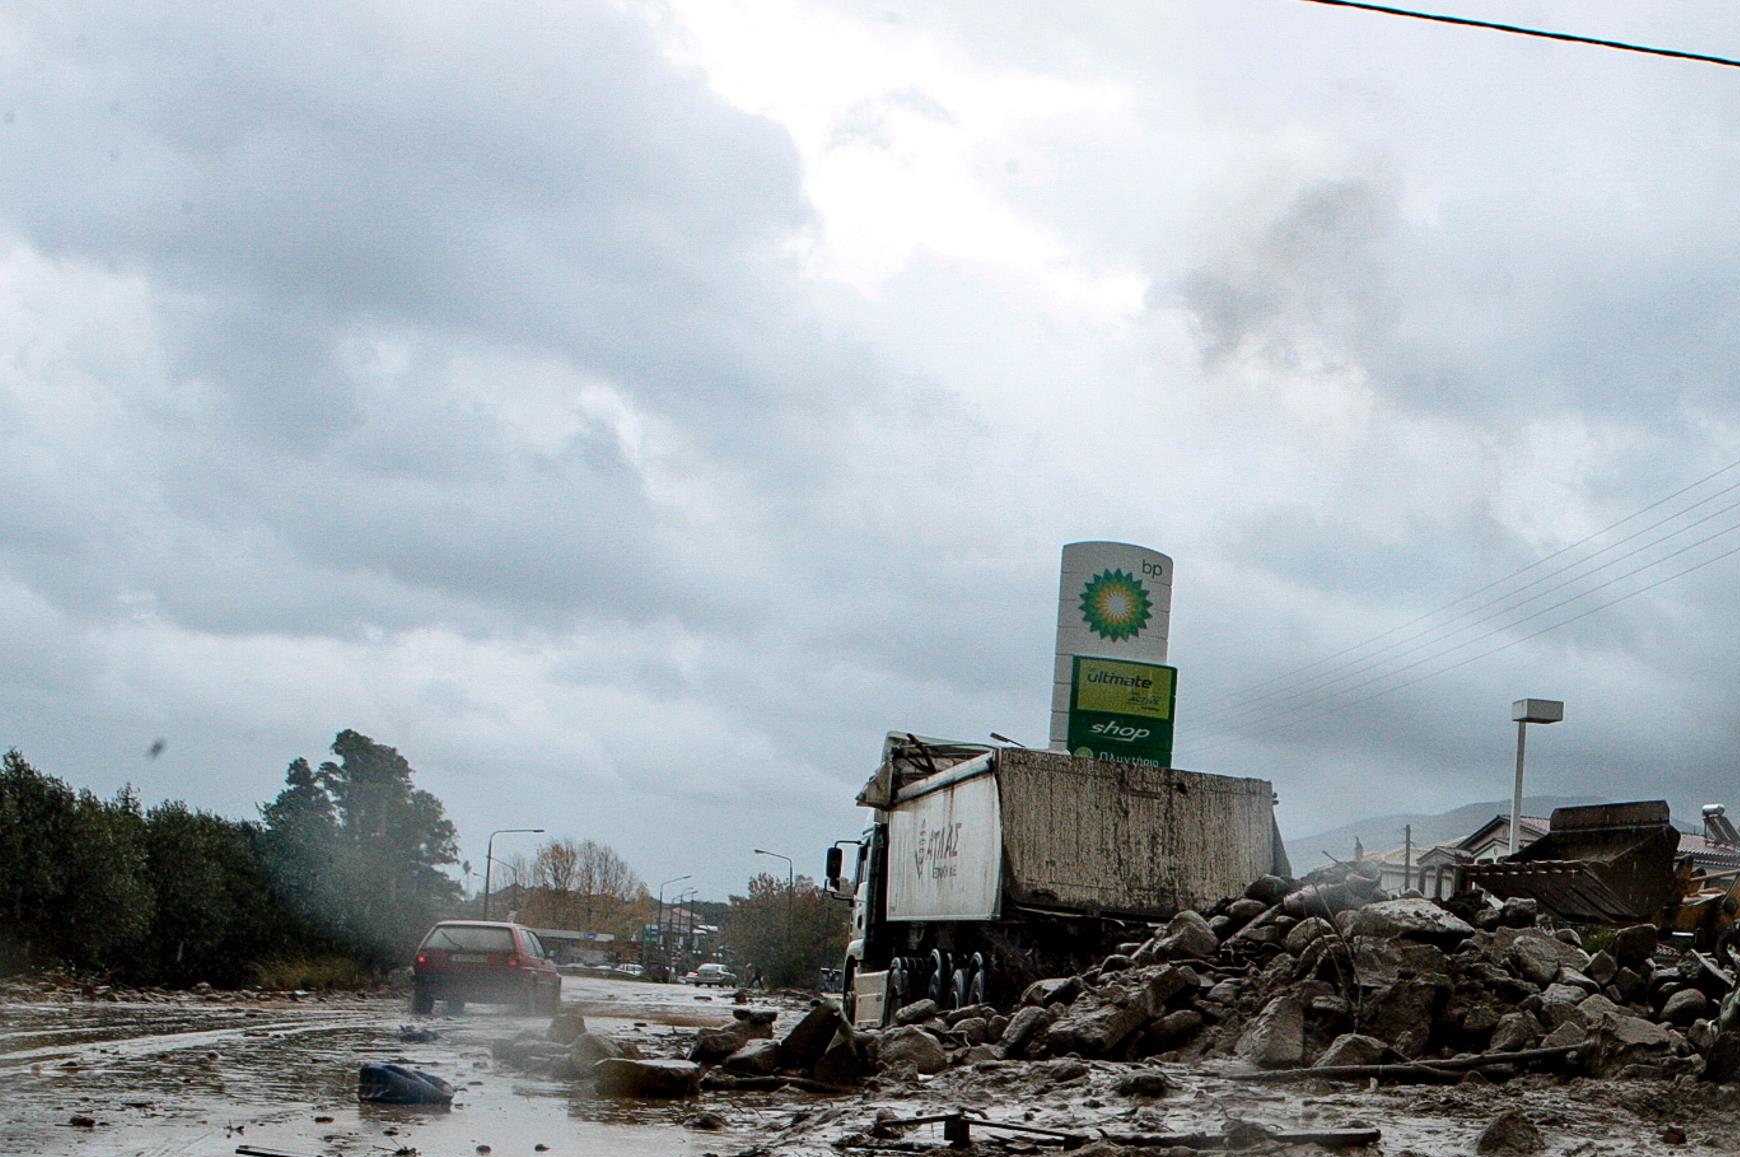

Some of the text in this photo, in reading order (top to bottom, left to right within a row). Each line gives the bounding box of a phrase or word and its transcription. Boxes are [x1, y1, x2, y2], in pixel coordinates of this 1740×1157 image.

[1142, 559, 1162, 580] bp
[1087, 671, 1152, 689] ultimate
[1089, 720, 1151, 742] shop
